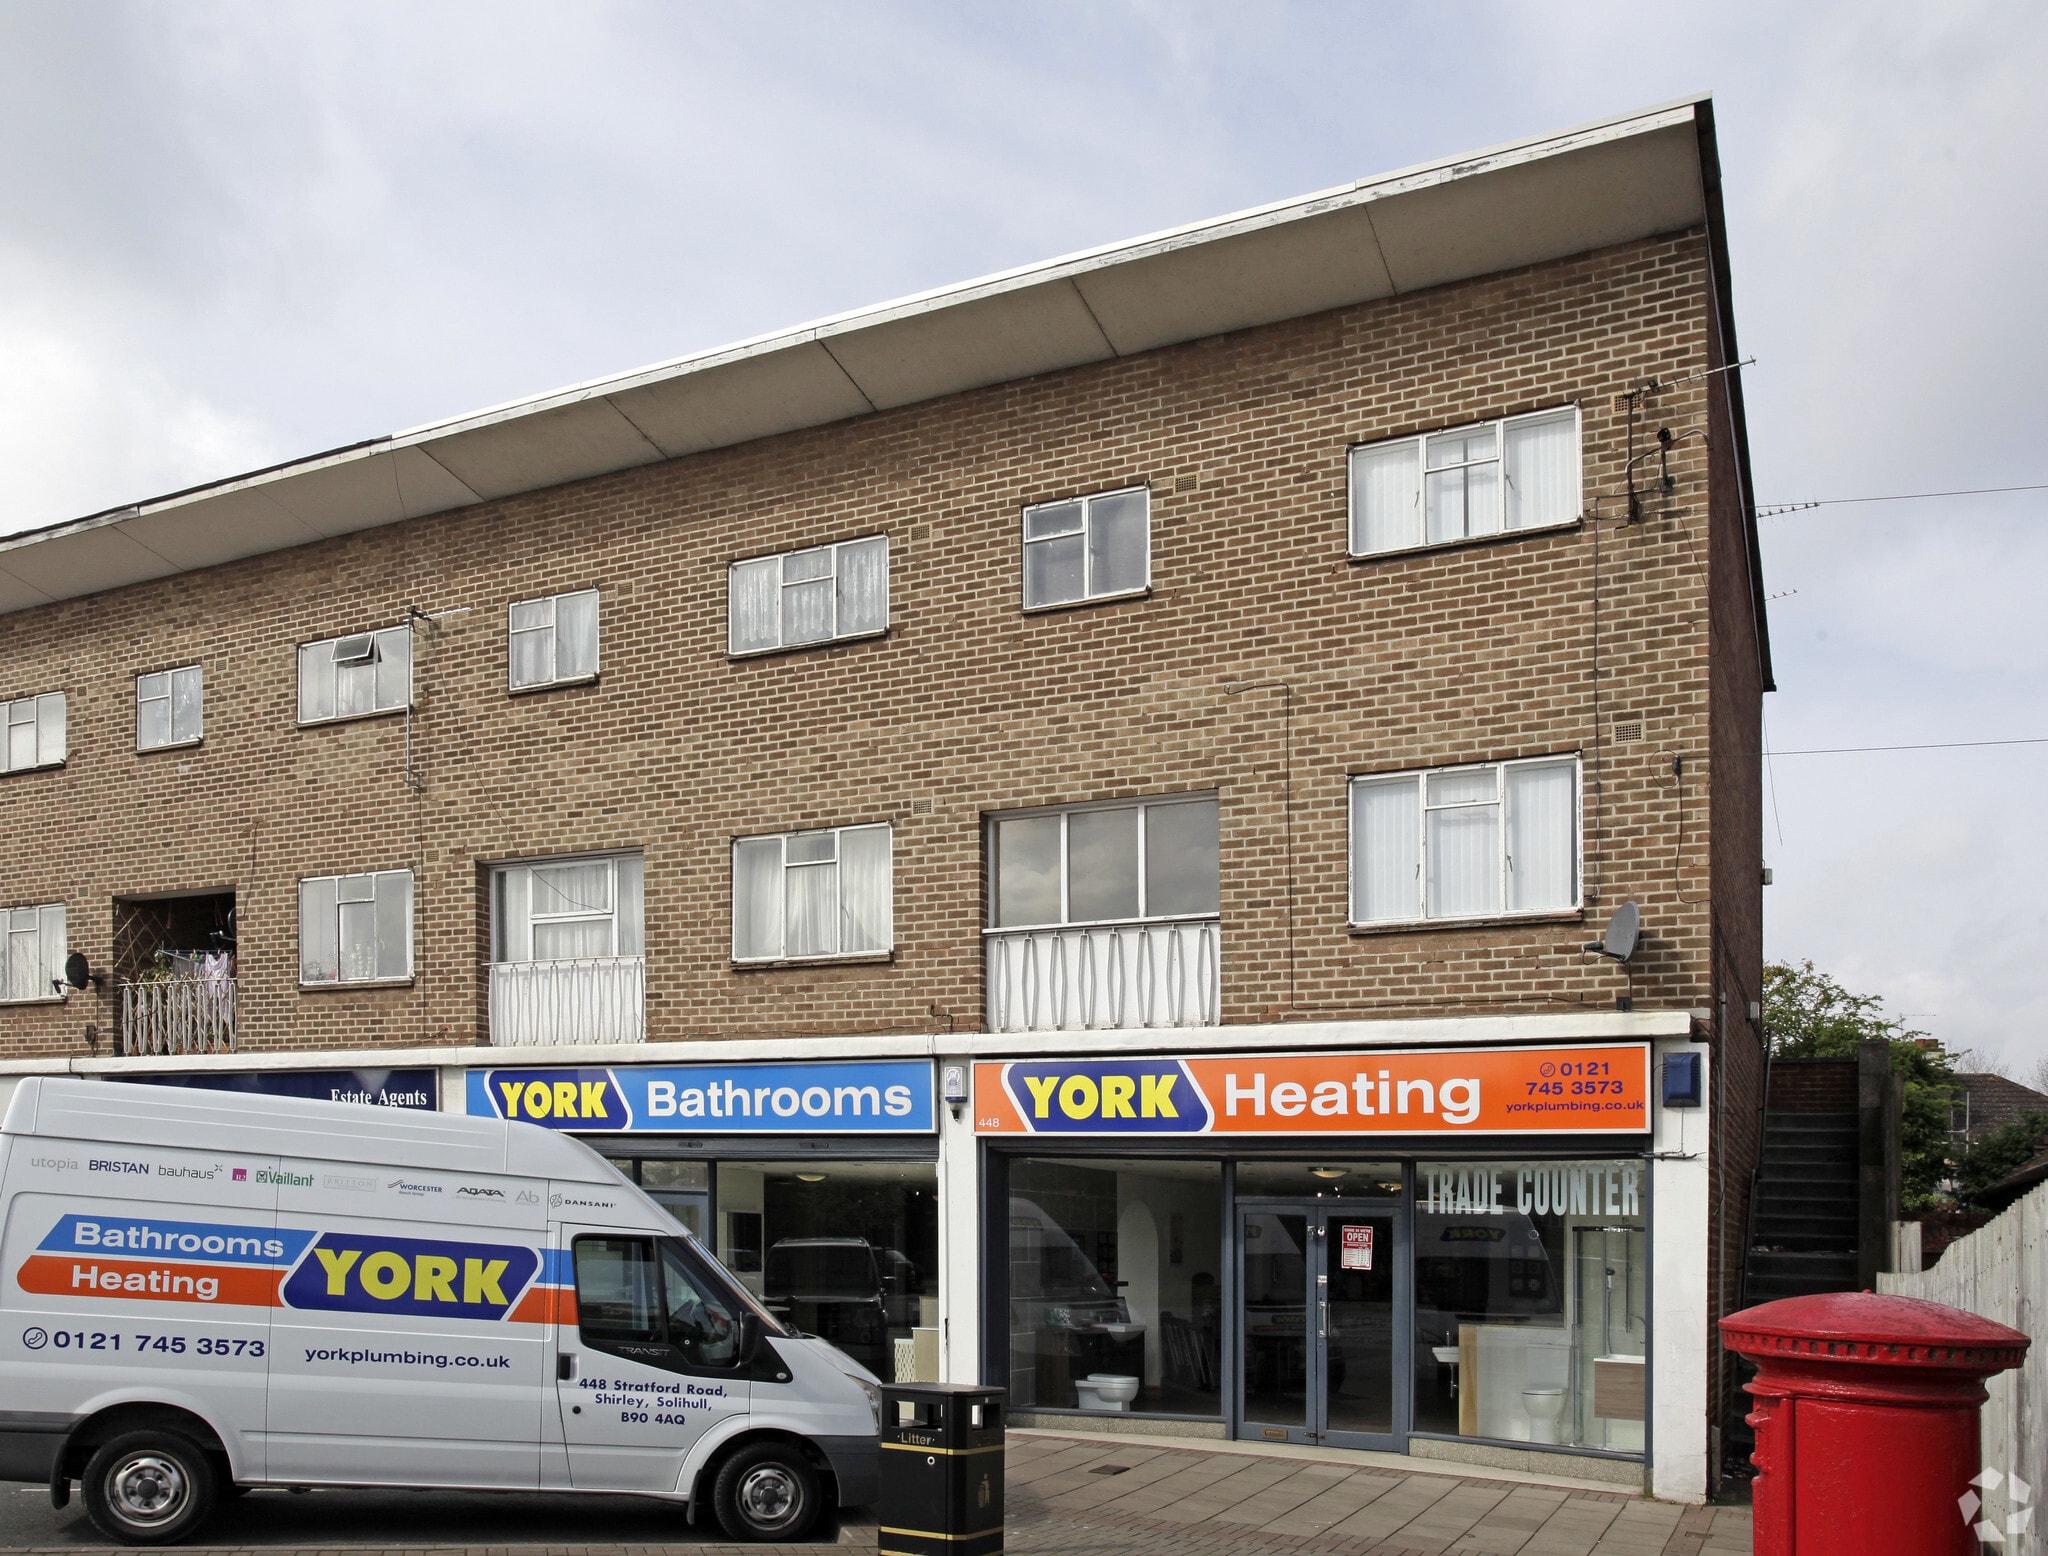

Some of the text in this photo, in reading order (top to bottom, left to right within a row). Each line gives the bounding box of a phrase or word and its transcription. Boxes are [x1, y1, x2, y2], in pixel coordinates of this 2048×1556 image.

[1560, 1062, 1610, 1077] 0121
[1526, 1080, 1624, 1096] 745 3573
[330, 1088, 427, 1108] Estate Agents
[499, 1081, 608, 1119] YORK
[647, 1080, 912, 1118] Bathrooms
[1023, 1074, 1179, 1120] YORK
[1225, 1070, 1480, 1124] Heating
[1506, 1100, 1644, 1113] yorkplumbing.co.uk
[978, 1117, 1000, 1128] 448
[31, 1158, 79, 1172] utopia
[88, 1159, 149, 1174] BRISTAN
[158, 1165, 215, 1180] bauhaus
[268, 1170, 315, 1187] Vaillant
[400, 1183, 443, 1193] WORCESTER
[1424, 1163, 1639, 1216] TRADE COUNTER
[515, 1189, 540, 1204] Ab
[564, 1199, 614, 1208] DANSANI
[74, 1221, 284, 1258] Bathrooms
[1346, 1232, 1369, 1242] OPEN
[71, 1264, 219, 1301] Heating
[313, 1248, 510, 1306] YORK
[54, 1330, 266, 1357] 0121 745 3573
[618, 1346, 670, 1356] TRANSIT
[304, 1346, 511, 1369] yorkplumbing.co.uk
[579, 1378, 728, 1398] 448 Stratford Road,
[595, 1393, 712, 1411] Shirley, Solihull,
[621, 1411, 686, 1425] B90 4AQ
[900, 1431, 932, 1445] Litter
